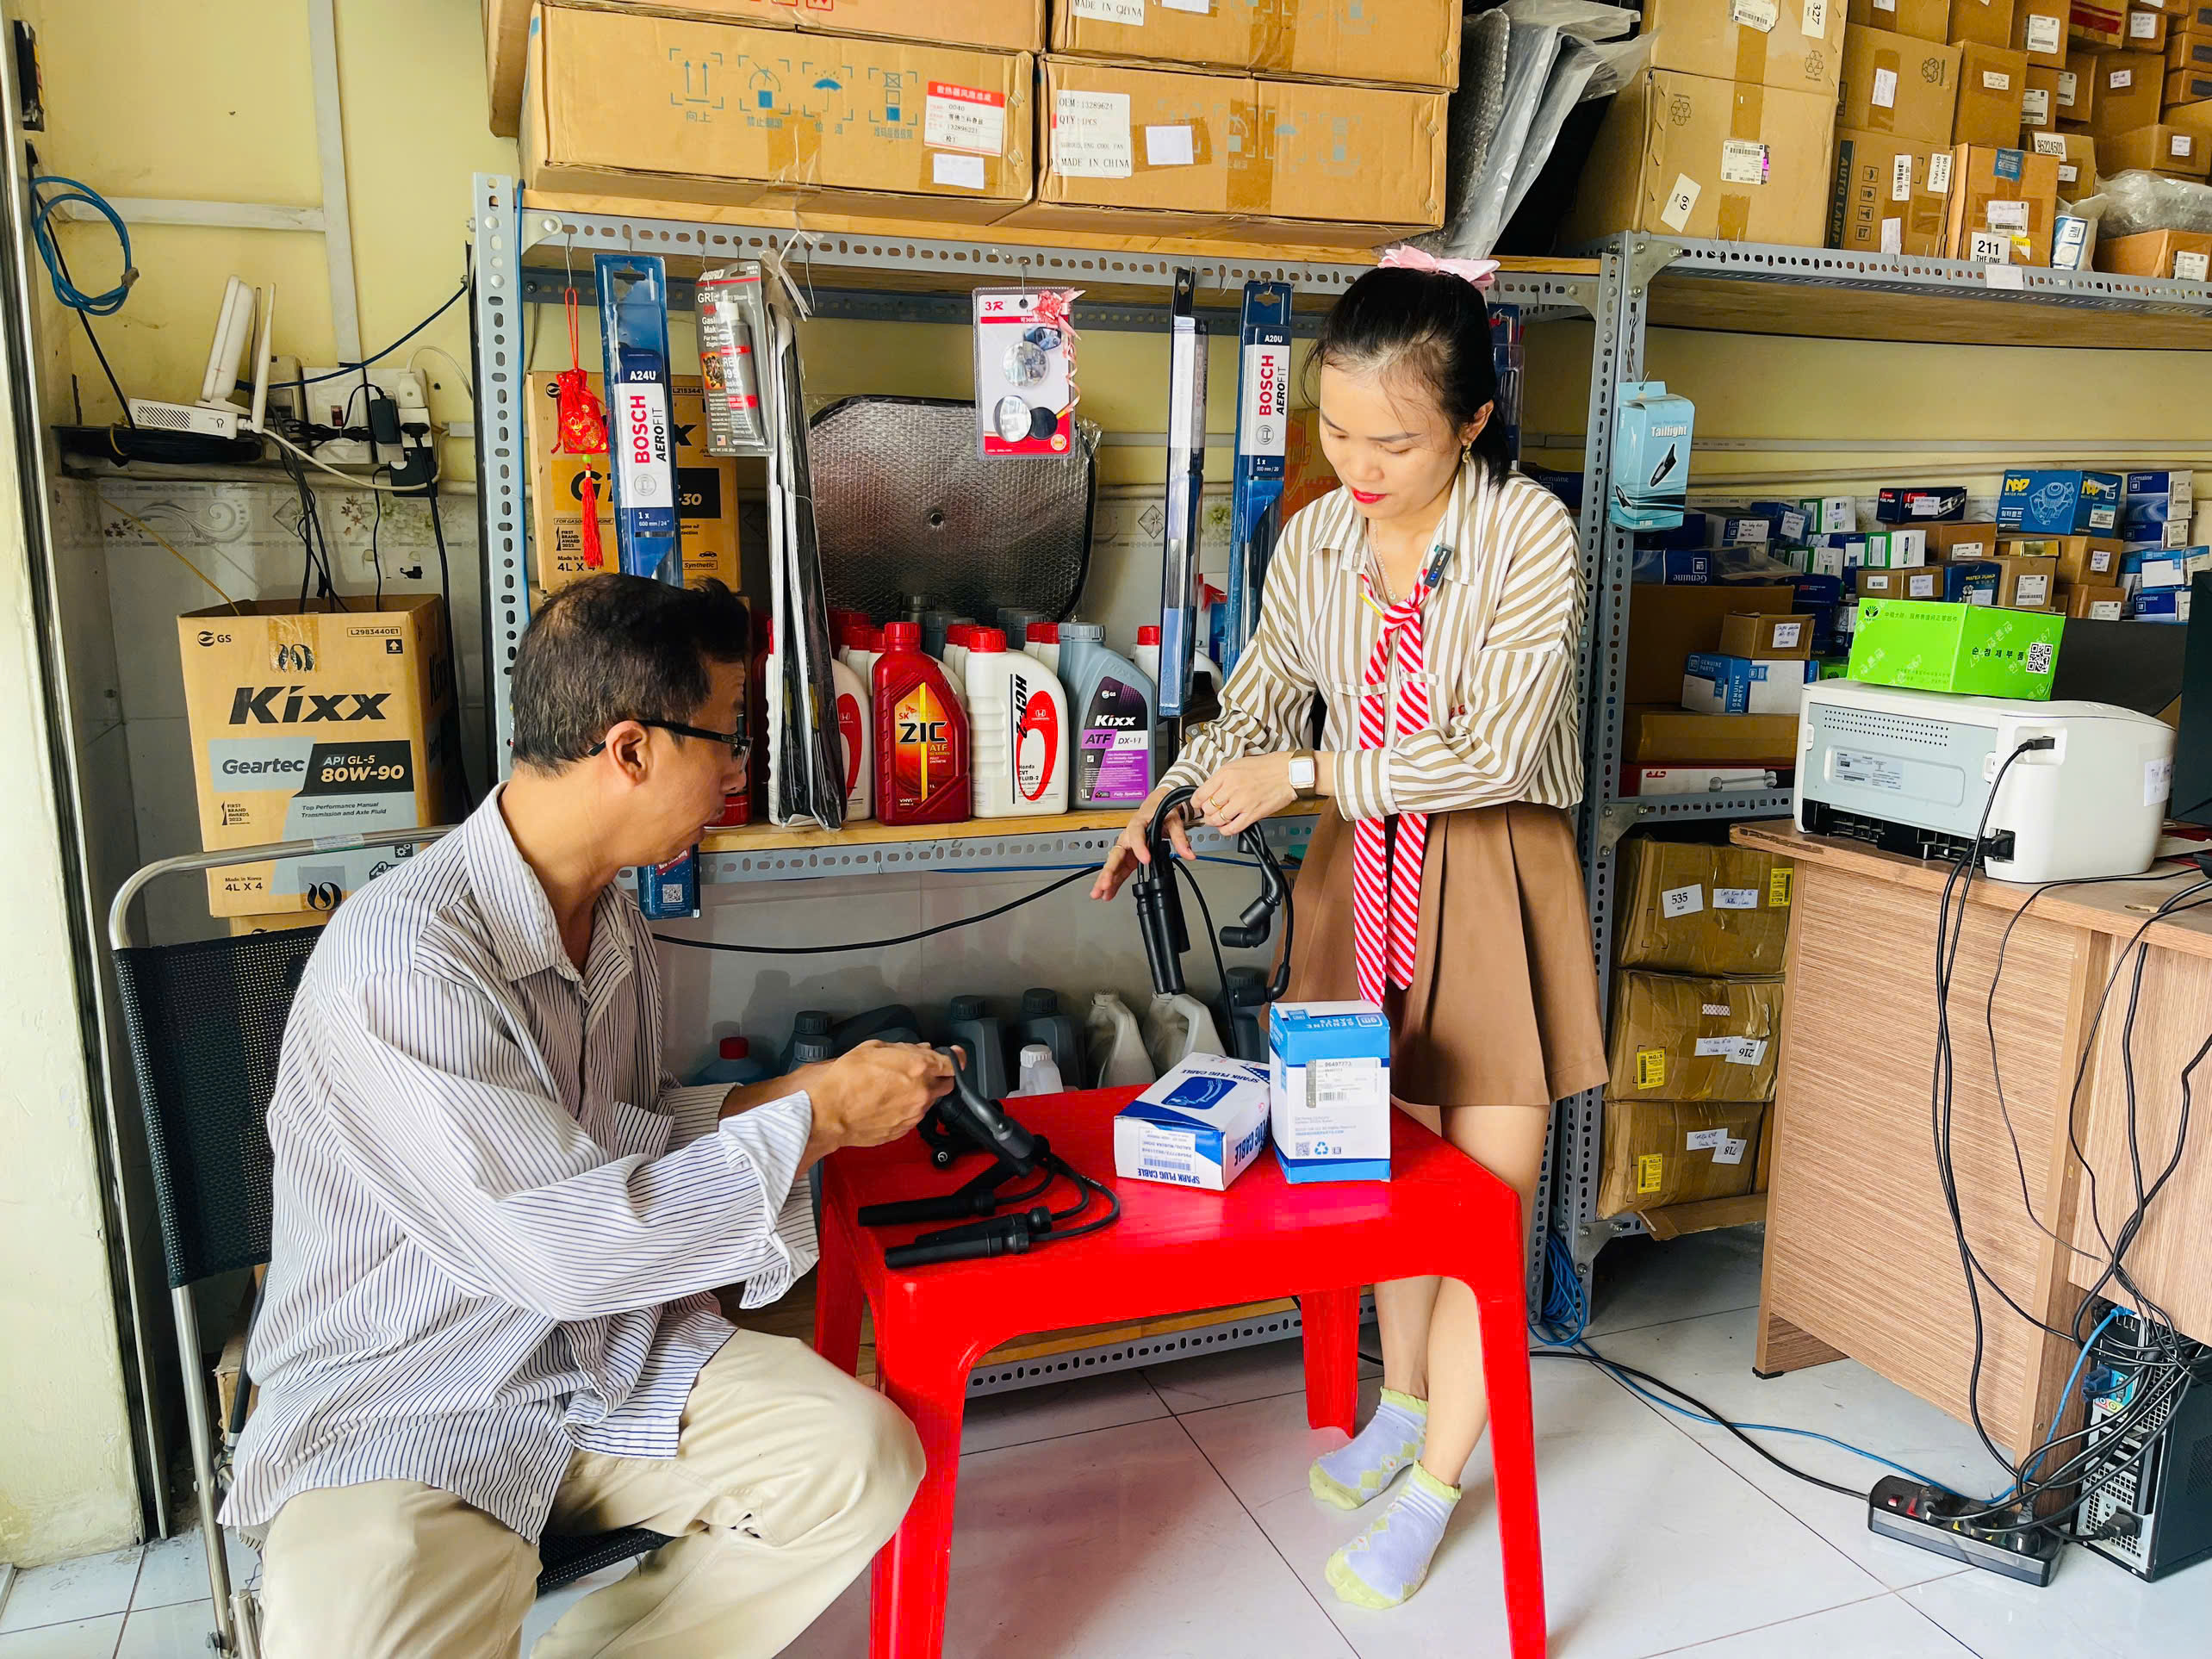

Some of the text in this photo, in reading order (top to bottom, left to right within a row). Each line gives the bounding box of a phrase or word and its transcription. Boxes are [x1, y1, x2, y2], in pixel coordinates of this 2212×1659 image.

[1812, 2, 1822, 25] 327
[686, 110, 713, 123] 向上
[1061, 158, 1130, 168] MADE IN CHINA
[1832, 156, 1849, 243] AUTO LAMP
[1978, 240, 1999, 255] 211
[1264, 334, 1283, 344] A20U
[630, 370, 656, 382] A24U
[1258, 355, 1275, 416] BOSCH
[1276, 366, 1287, 416] AEROFIT
[630, 395, 650, 463] BOSCH
[652, 407, 667, 463] AEROFIT
[1651, 426, 1687, 438] Taillight
[557, 562, 584, 572] 4L X
[1673, 574, 1707, 584] Genuine
[216, 634, 232, 643] GS
[351, 628, 400, 637] L2983440E1
[1700, 659, 1722, 668] GENUINE
[228, 686, 392, 725] Kixx
[1016, 674, 1028, 739] HCF-2
[1095, 714, 1136, 726] Kixx
[898, 721, 948, 744] ZIC
[1085, 734, 1112, 744] ATF
[930, 743, 948, 752] ATF
[222, 758, 305, 774] Geartec
[323, 755, 376, 766] API GL-5
[320, 765, 405, 783] 80W-90
[1081, 789, 1090, 798] 1L
[226, 883, 240, 892] 4L
[244, 883, 253, 892] X
[1671, 892, 1688, 904] 535
[1307, 1020, 1355, 1028] GENUINE
[1738, 1048, 1755, 1058] 216
[1232, 1074, 1259, 1084] SPARK
[1234, 1132, 1253, 1166] CABLE
[1724, 1146, 1737, 1156] 718
[1137, 1168, 1200, 1184] SPARK PLUG CABLE
